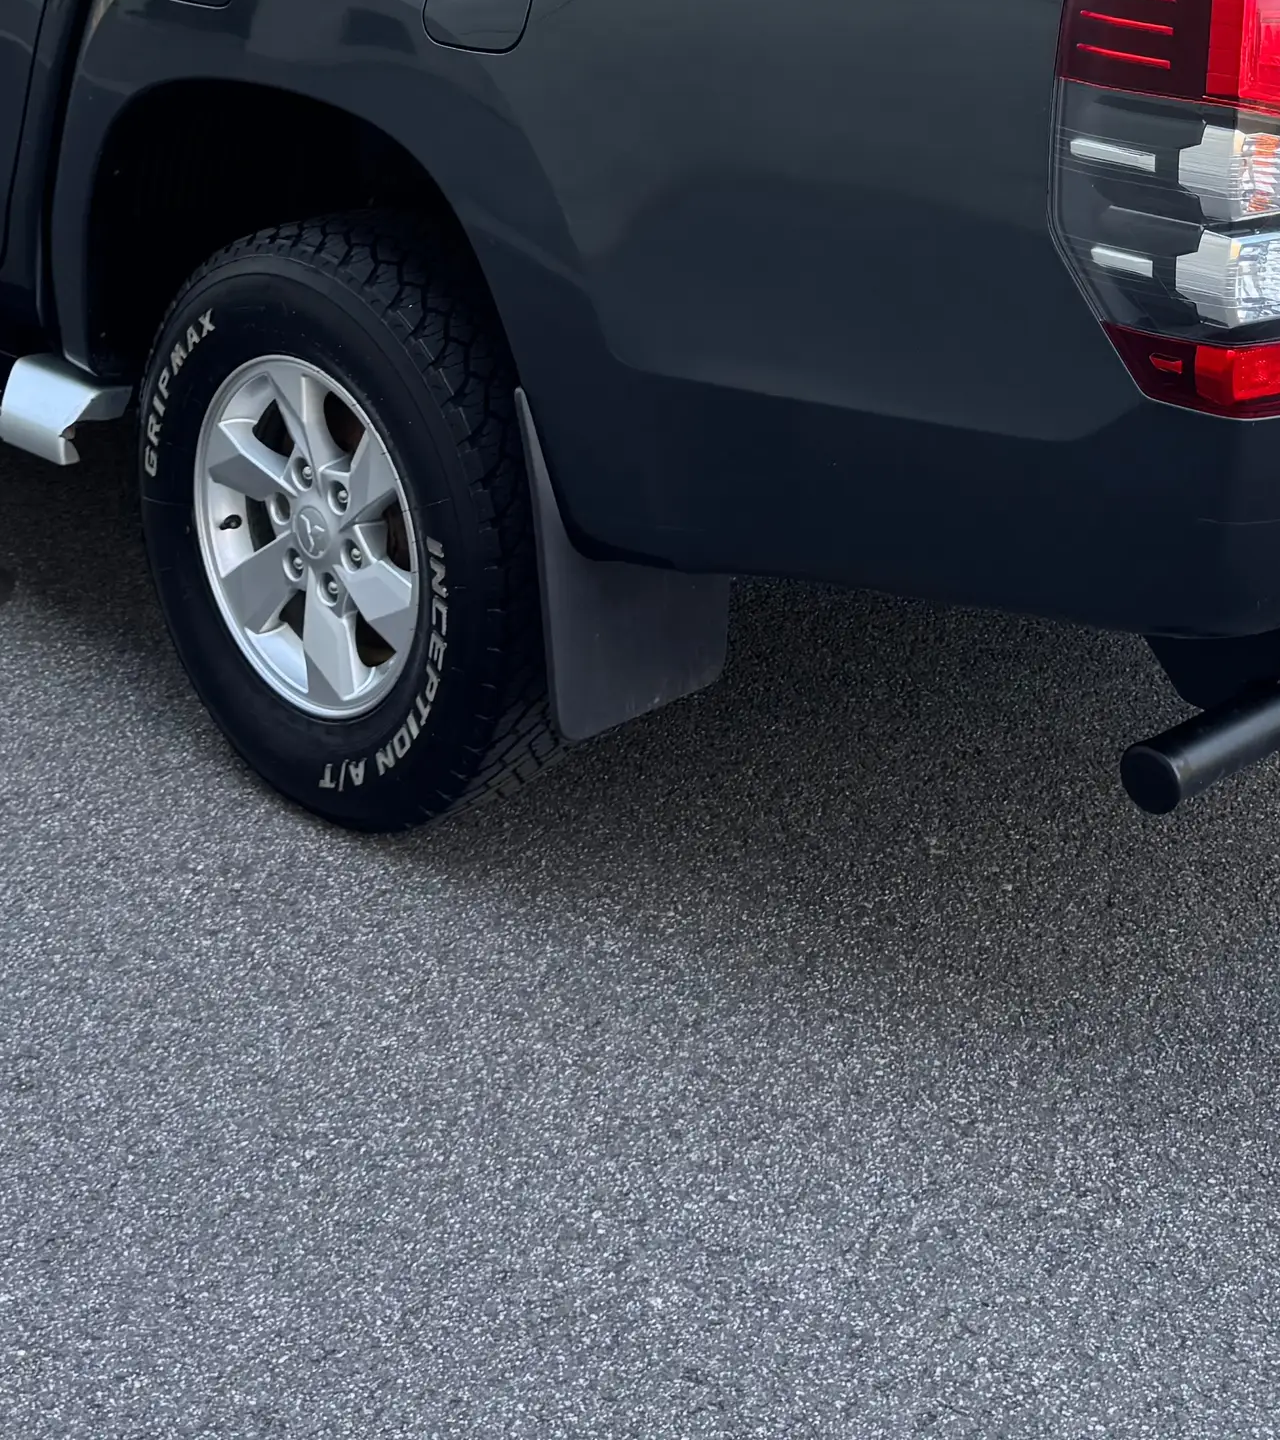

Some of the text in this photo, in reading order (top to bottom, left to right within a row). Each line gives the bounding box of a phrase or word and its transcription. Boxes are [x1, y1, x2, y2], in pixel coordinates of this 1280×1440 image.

[144, 308, 216, 477] GRIPMAX
[319, 536, 449, 792] INCEPTION A/T
